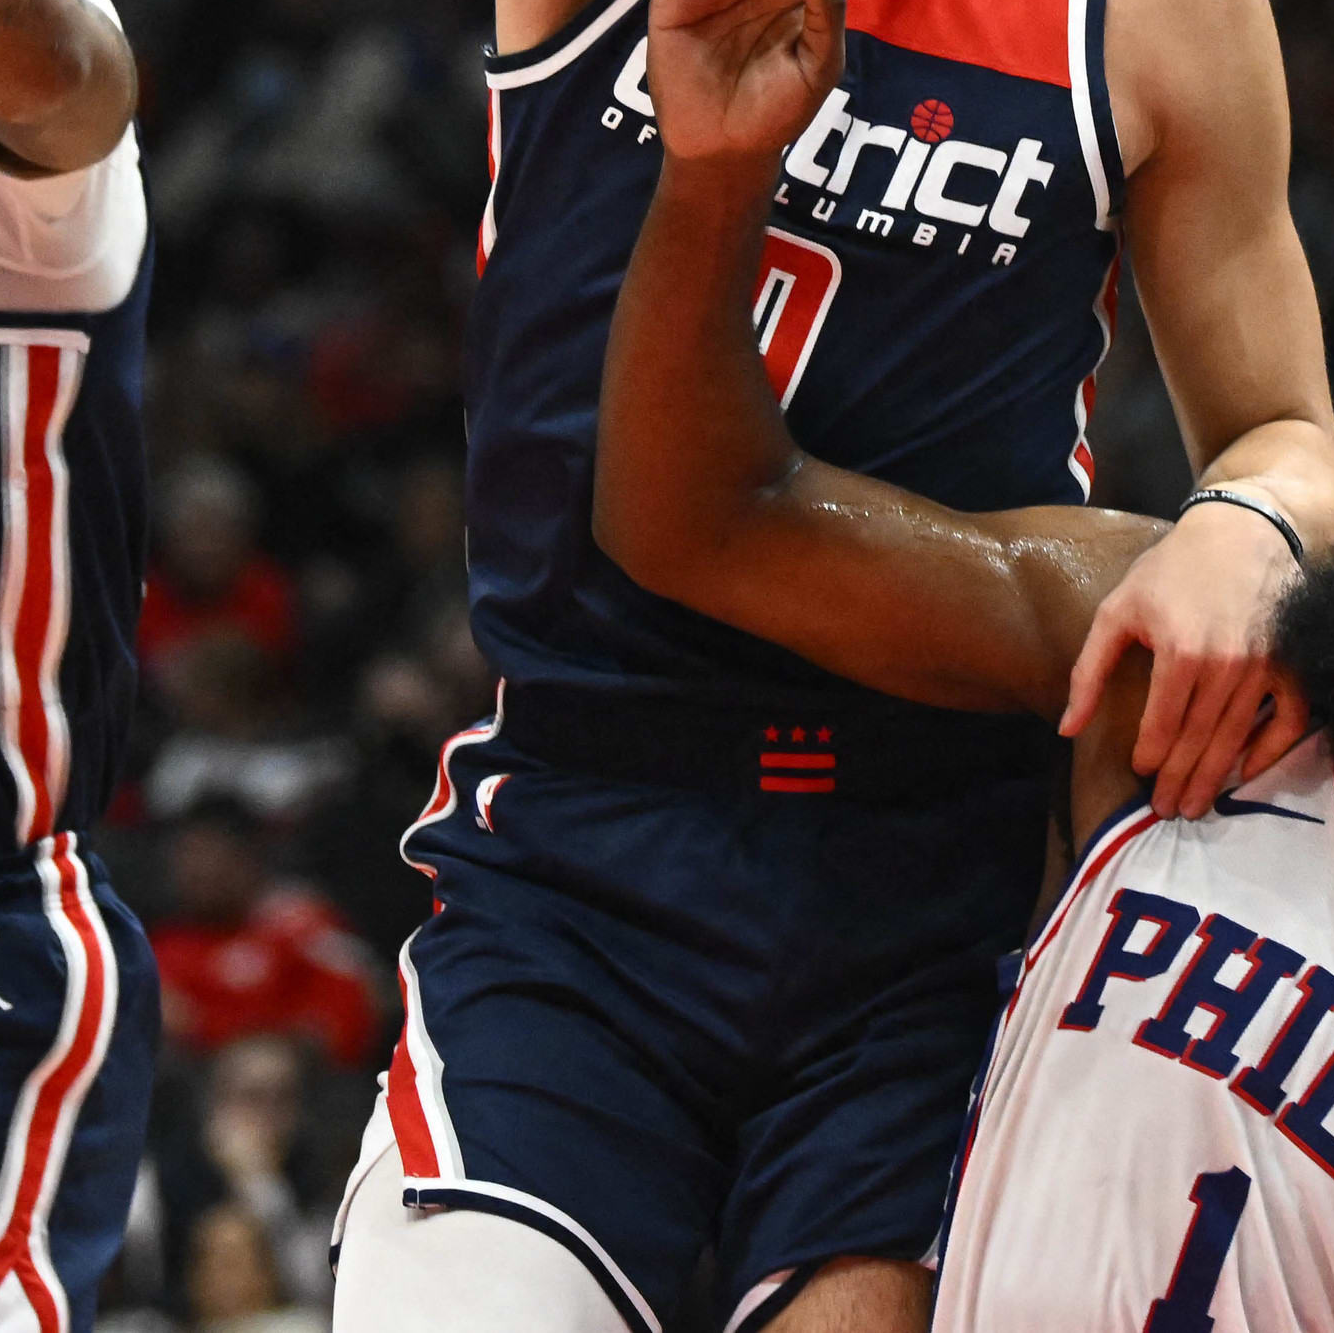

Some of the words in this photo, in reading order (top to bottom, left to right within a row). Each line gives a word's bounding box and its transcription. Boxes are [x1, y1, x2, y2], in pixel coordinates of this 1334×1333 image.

[600, 106, 658, 145] OF
[773, 182, 1018, 266] LUMBIA
[1142, 1166, 1252, 1333] 1
